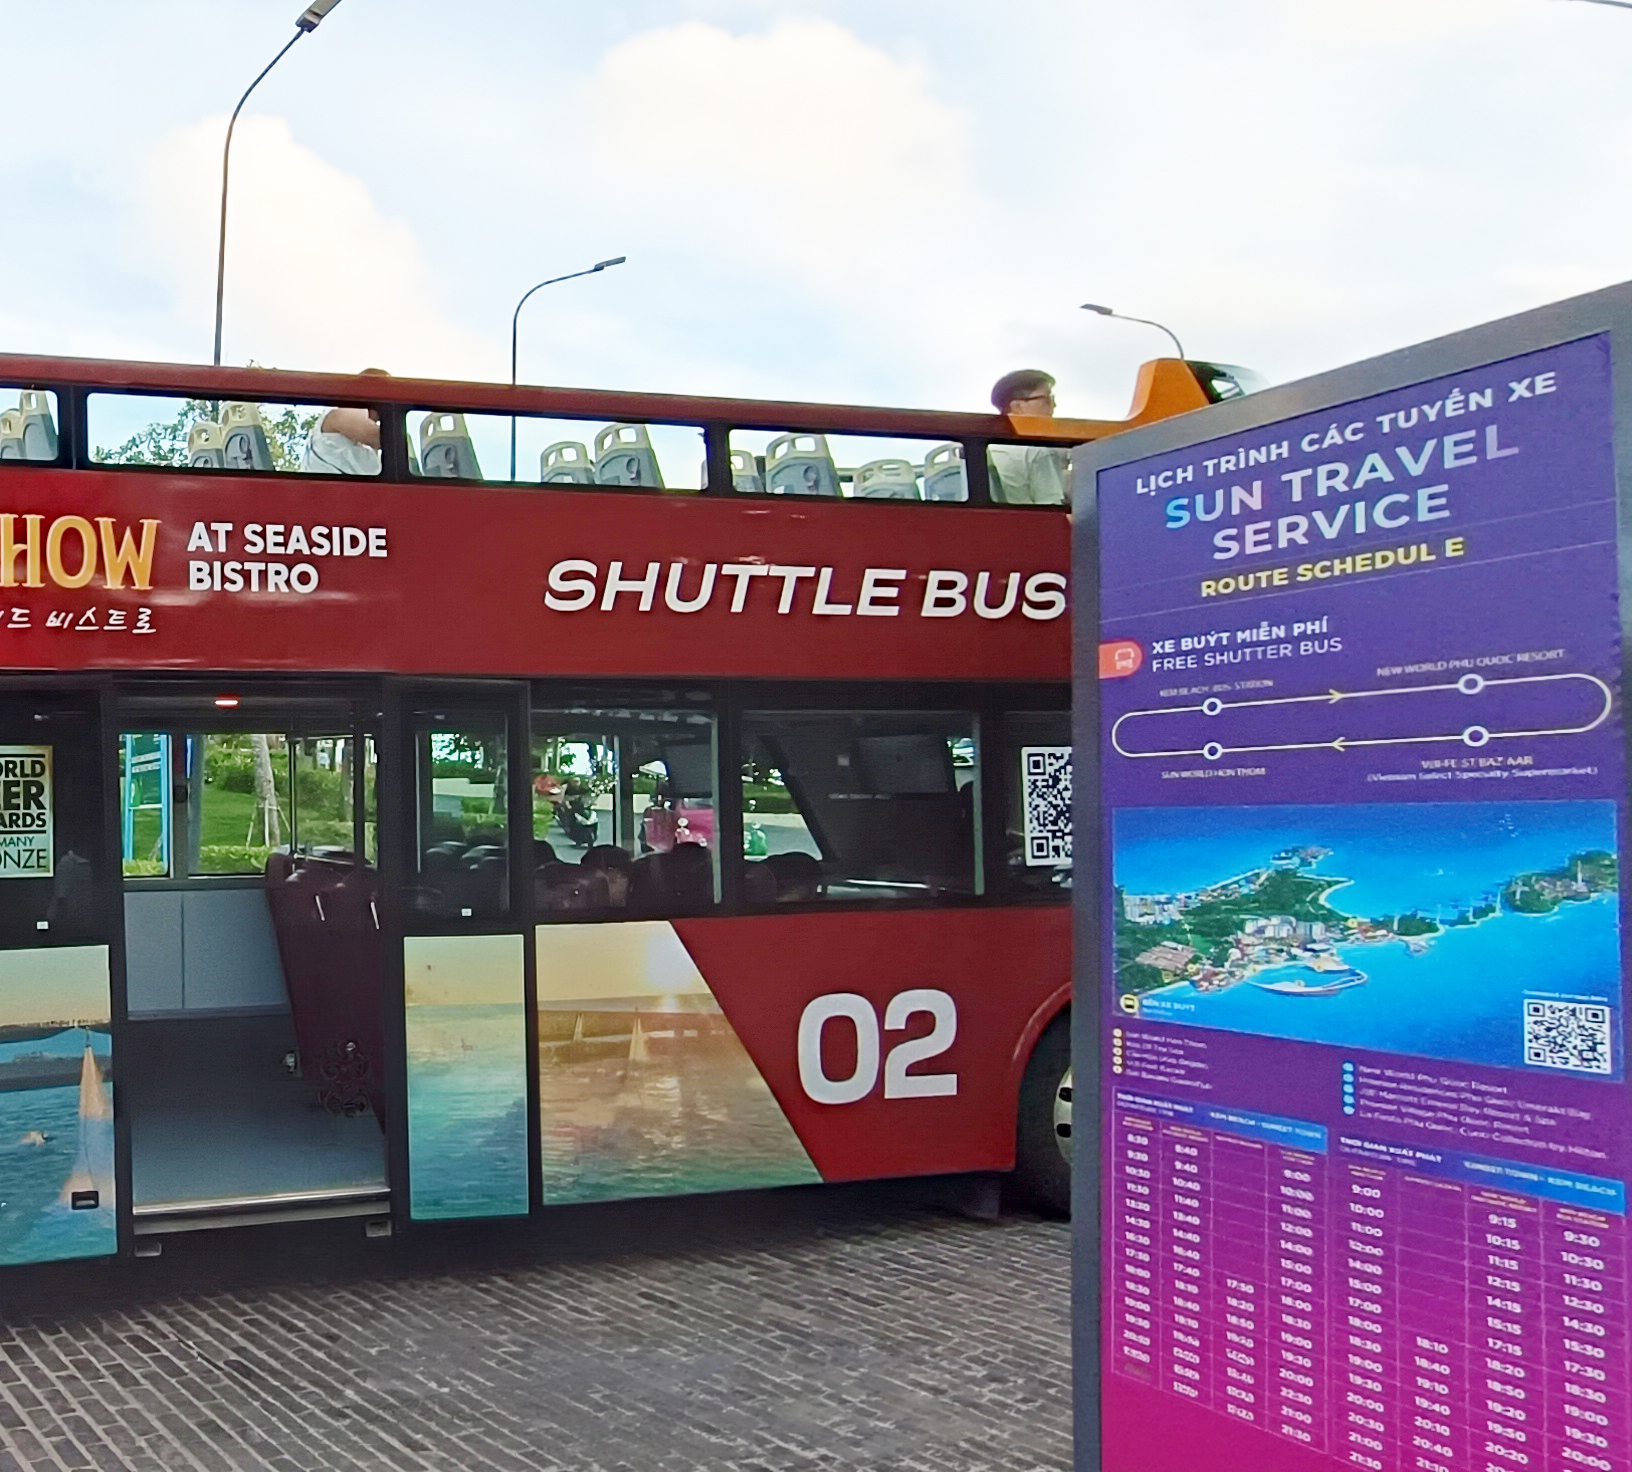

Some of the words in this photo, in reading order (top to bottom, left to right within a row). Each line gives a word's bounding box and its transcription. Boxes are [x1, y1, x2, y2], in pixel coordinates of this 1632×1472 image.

[1136, 463, 1194, 497] LỊCH
[1203, 438, 1290, 478] TRÌNH
[1300, 422, 1365, 454] CÁC
[1508, 371, 1557, 403] XE
[1165, 480, 1265, 530] SUN
[1281, 423, 1520, 503] TRAVEL
[1212, 484, 1451, 560] SERVICE
[187, 521, 235, 553] AT
[242, 523, 389, 559] SEASIDE
[188, 559, 319, 594] BISTRO
[1200, 568, 1289, 598] ROUTE
[544, 559, 907, 617] SHUTTLE
[920, 570, 1067, 621] BUS
[45, 605, 157, 636] 비스트로
[1151, 638, 1176, 656] XE
[1180, 629, 1232, 653] BUÝT
[1292, 616, 1329, 641] PHÍ
[1152, 655, 1199, 673] FREE
[1203, 643, 1294, 668] SHUTTER
[1299, 637, 1343, 656] BUS
[797, 988, 958, 1105] 02
[1351, 1184, 1382, 1199] 9:00
[1349, 1202, 1385, 1219] 10:00
[1487, 1213, 1517, 1229] 9:15
[1350, 1221, 1384, 1237] 11:00
[1563, 1230, 1601, 1248] 9:30
[1280, 1239, 1314, 1256] 14:00
[1485, 1233, 1521, 1251] 10:15
[1280, 1258, 1313, 1275] 15:00
[1487, 1254, 1520, 1271] 11:15
[1560, 1251, 1606, 1271] 10:30
[1280, 1276, 1313, 1293] 17:00
[1486, 1274, 1521, 1292] 12:15
[1563, 1273, 1604, 1292] 11:30
[1347, 1296, 1383, 1314] 17:00
[1486, 1295, 1522, 1314] 14:15
[1562, 1294, 1605, 1314] 12:30
[1486, 1316, 1523, 1335] 15:15
[1562, 1316, 1606, 1337] 14:30
[1416, 1336, 1450, 1354] 18:10
[1486, 1337, 1523, 1356] 17:15
[1563, 1338, 1606, 1359] 15:30
[1414, 1356, 1451, 1375] 18:40
[1484, 1357, 1526, 1378] 18:20
[1563, 1360, 1607, 1381] 17:30
[1279, 1368, 1315, 1387] 20:00
[1346, 1391, 1385, 1413] 20:00
[1563, 1381, 1607, 1404] 18:30
[1414, 1396, 1451, 1416] 19:40
[1485, 1399, 1527, 1421] 19:20
[1563, 1404, 1610, 1426] 19:00
[1347, 1411, 1385, 1432] 20:30
[1414, 1416, 1451, 1437] 20:10
[1348, 1431, 1384, 1451] 21:00
[1412, 1435, 1454, 1458] 20:40
[1564, 1425, 1609, 1448] 19:30
[1484, 1441, 1529, 1465] 20:20
[1561, 1446, 1613, 1472] 20:00
